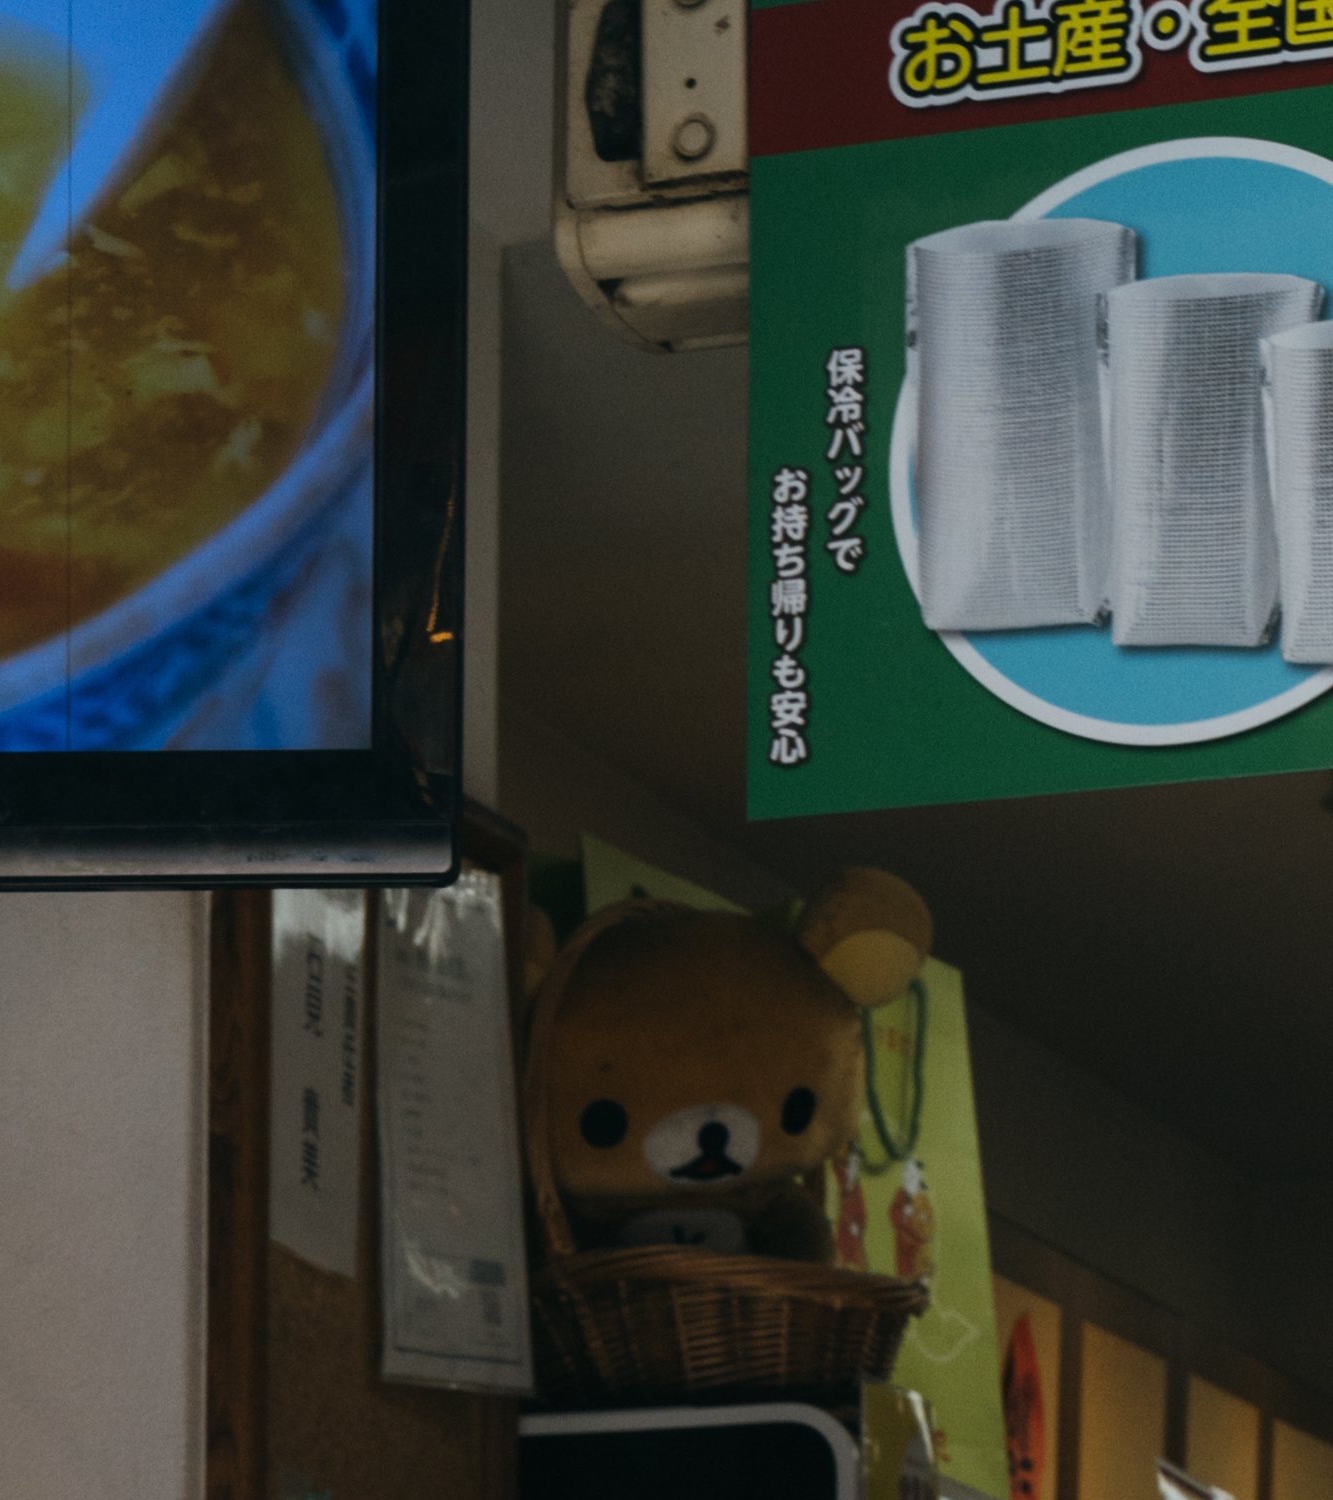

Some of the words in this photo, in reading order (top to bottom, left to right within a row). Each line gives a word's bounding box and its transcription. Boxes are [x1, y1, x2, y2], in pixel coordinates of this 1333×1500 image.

[827, 348, 863, 572] 保冷バッグで
[770, 469, 807, 764] お持ち帰りも安心
